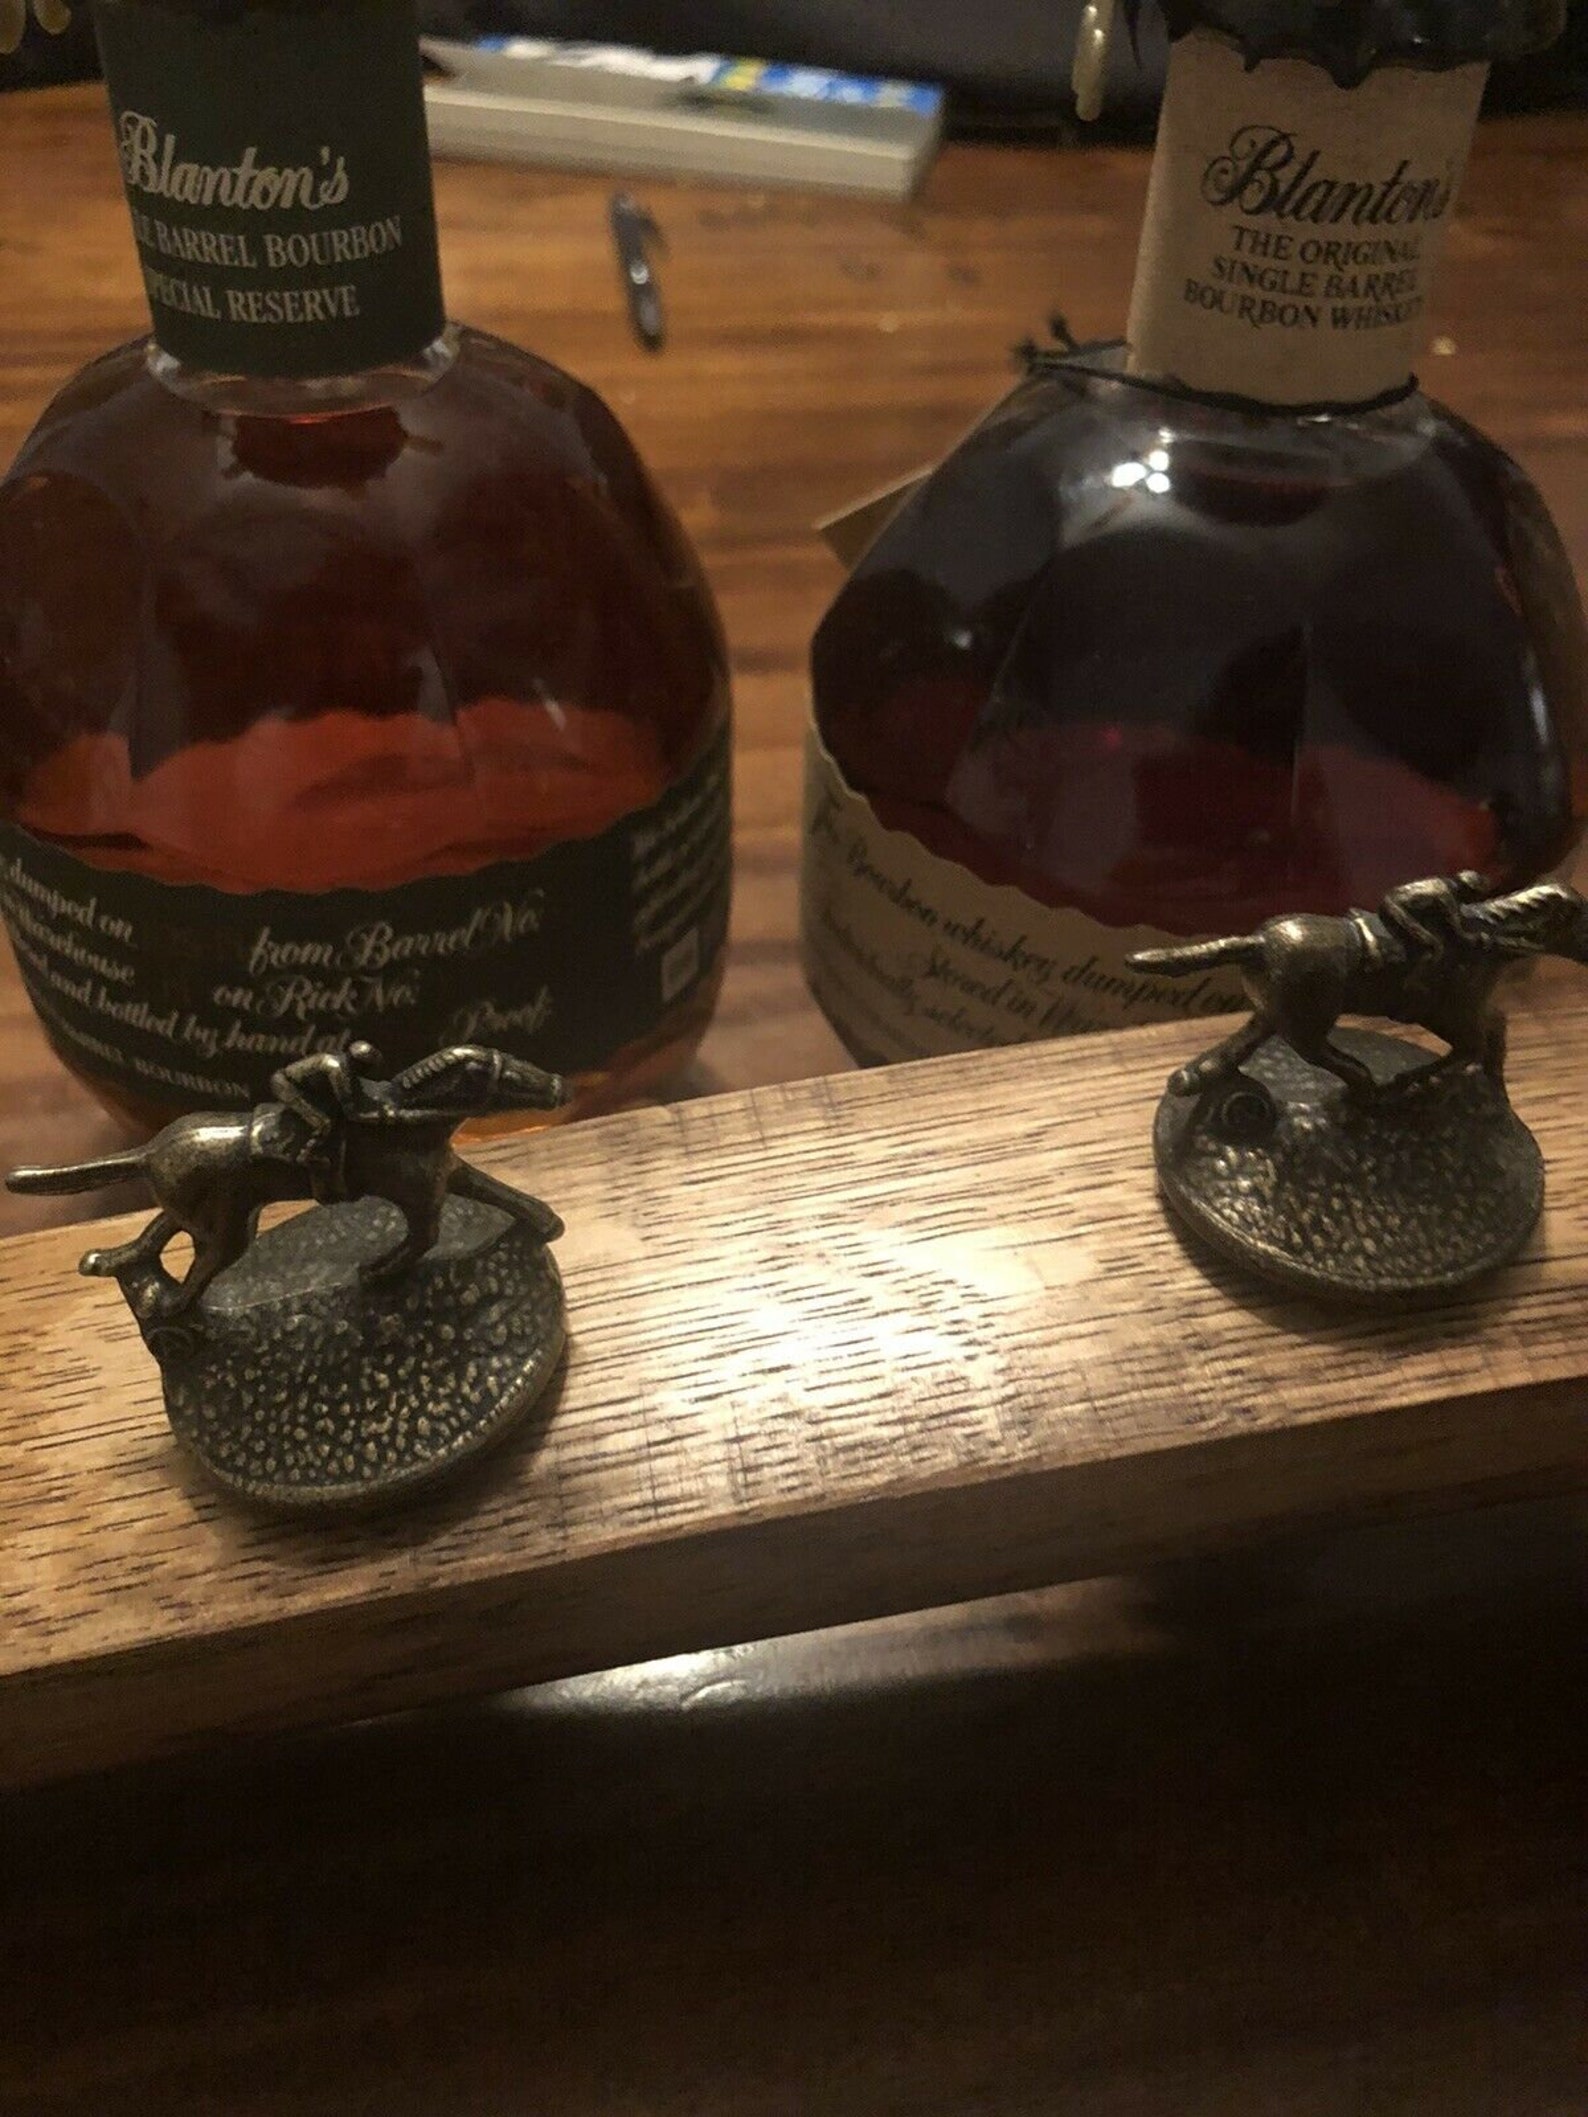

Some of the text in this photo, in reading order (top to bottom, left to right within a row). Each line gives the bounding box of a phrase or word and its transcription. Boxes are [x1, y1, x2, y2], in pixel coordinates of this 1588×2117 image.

[119, 110, 350, 211] Blanton's
[154, 218, 258, 268] BARREL
[263, 214, 403, 269] BOURBON
[1231, 225, 1294, 261] THE
[1212, 256, 1318, 298] SINGLE
[224, 284, 361, 324] RESERVE
[1182, 279, 1318, 330] BOURBON
[248, 926, 334, 978] from
[212, 984, 254, 1011] on
[1060, 955, 1213, 1010] dumped
